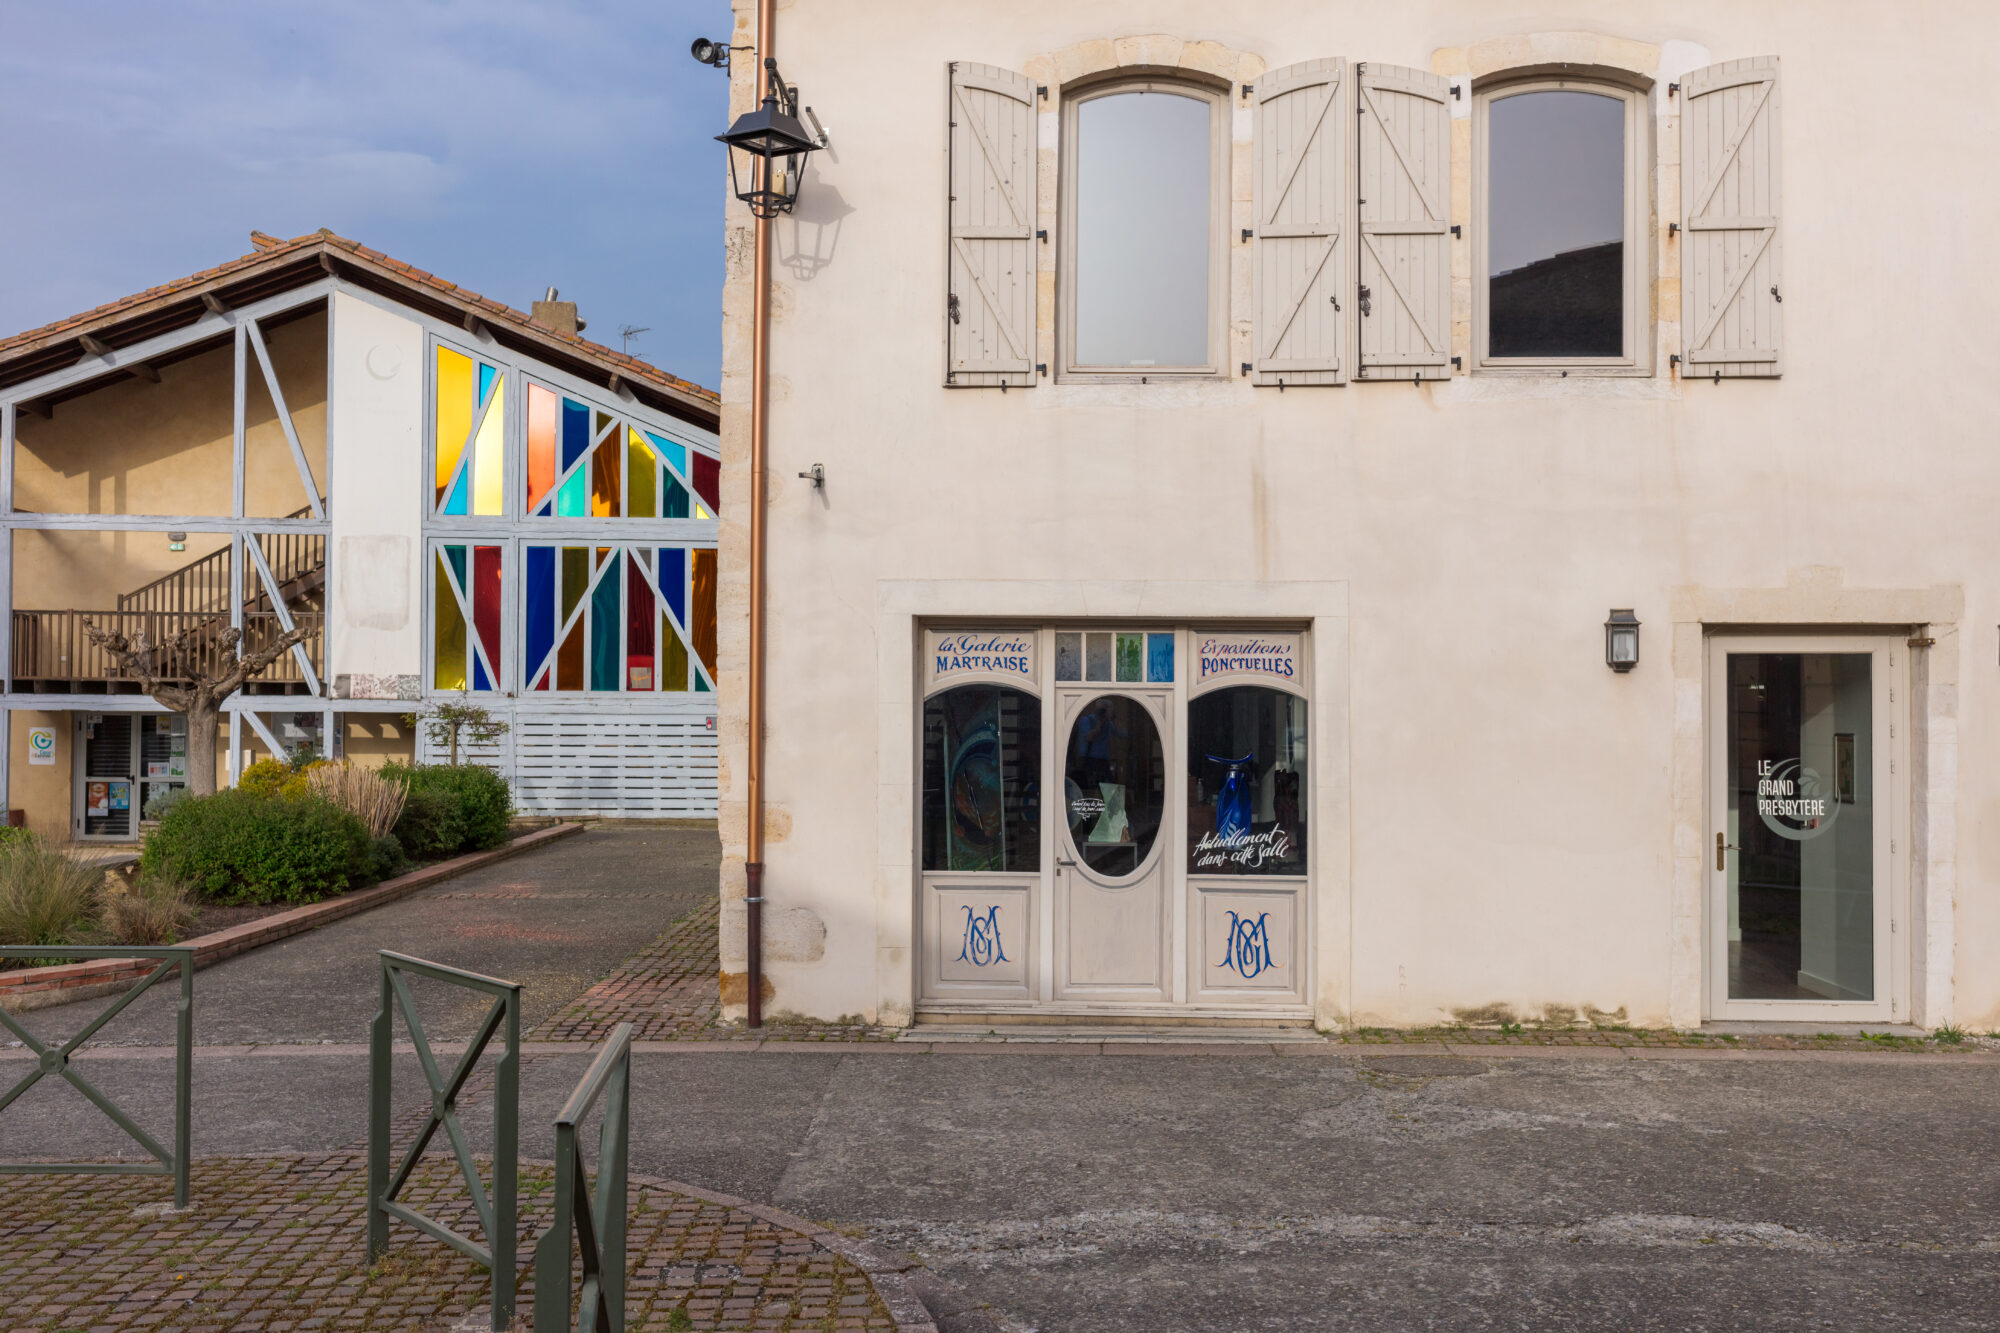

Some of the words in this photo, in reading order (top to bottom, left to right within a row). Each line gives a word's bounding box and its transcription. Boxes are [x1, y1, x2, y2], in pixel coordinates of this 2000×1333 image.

[938, 637, 954, 652] la
[954, 634, 1031, 655] Galerie
[1201, 639, 1291, 656] Expositions
[936, 656, 1029, 673] MARTRAISE
[1201, 658, 1294, 676] PONCTUELLES
[1758, 760, 1771, 776] LE
[1759, 780, 1794, 796] GRAND
[1193, 823, 1285, 856] Actuellement
[1197, 852, 1228, 867] dans
[1231, 845, 1256, 864] cette
